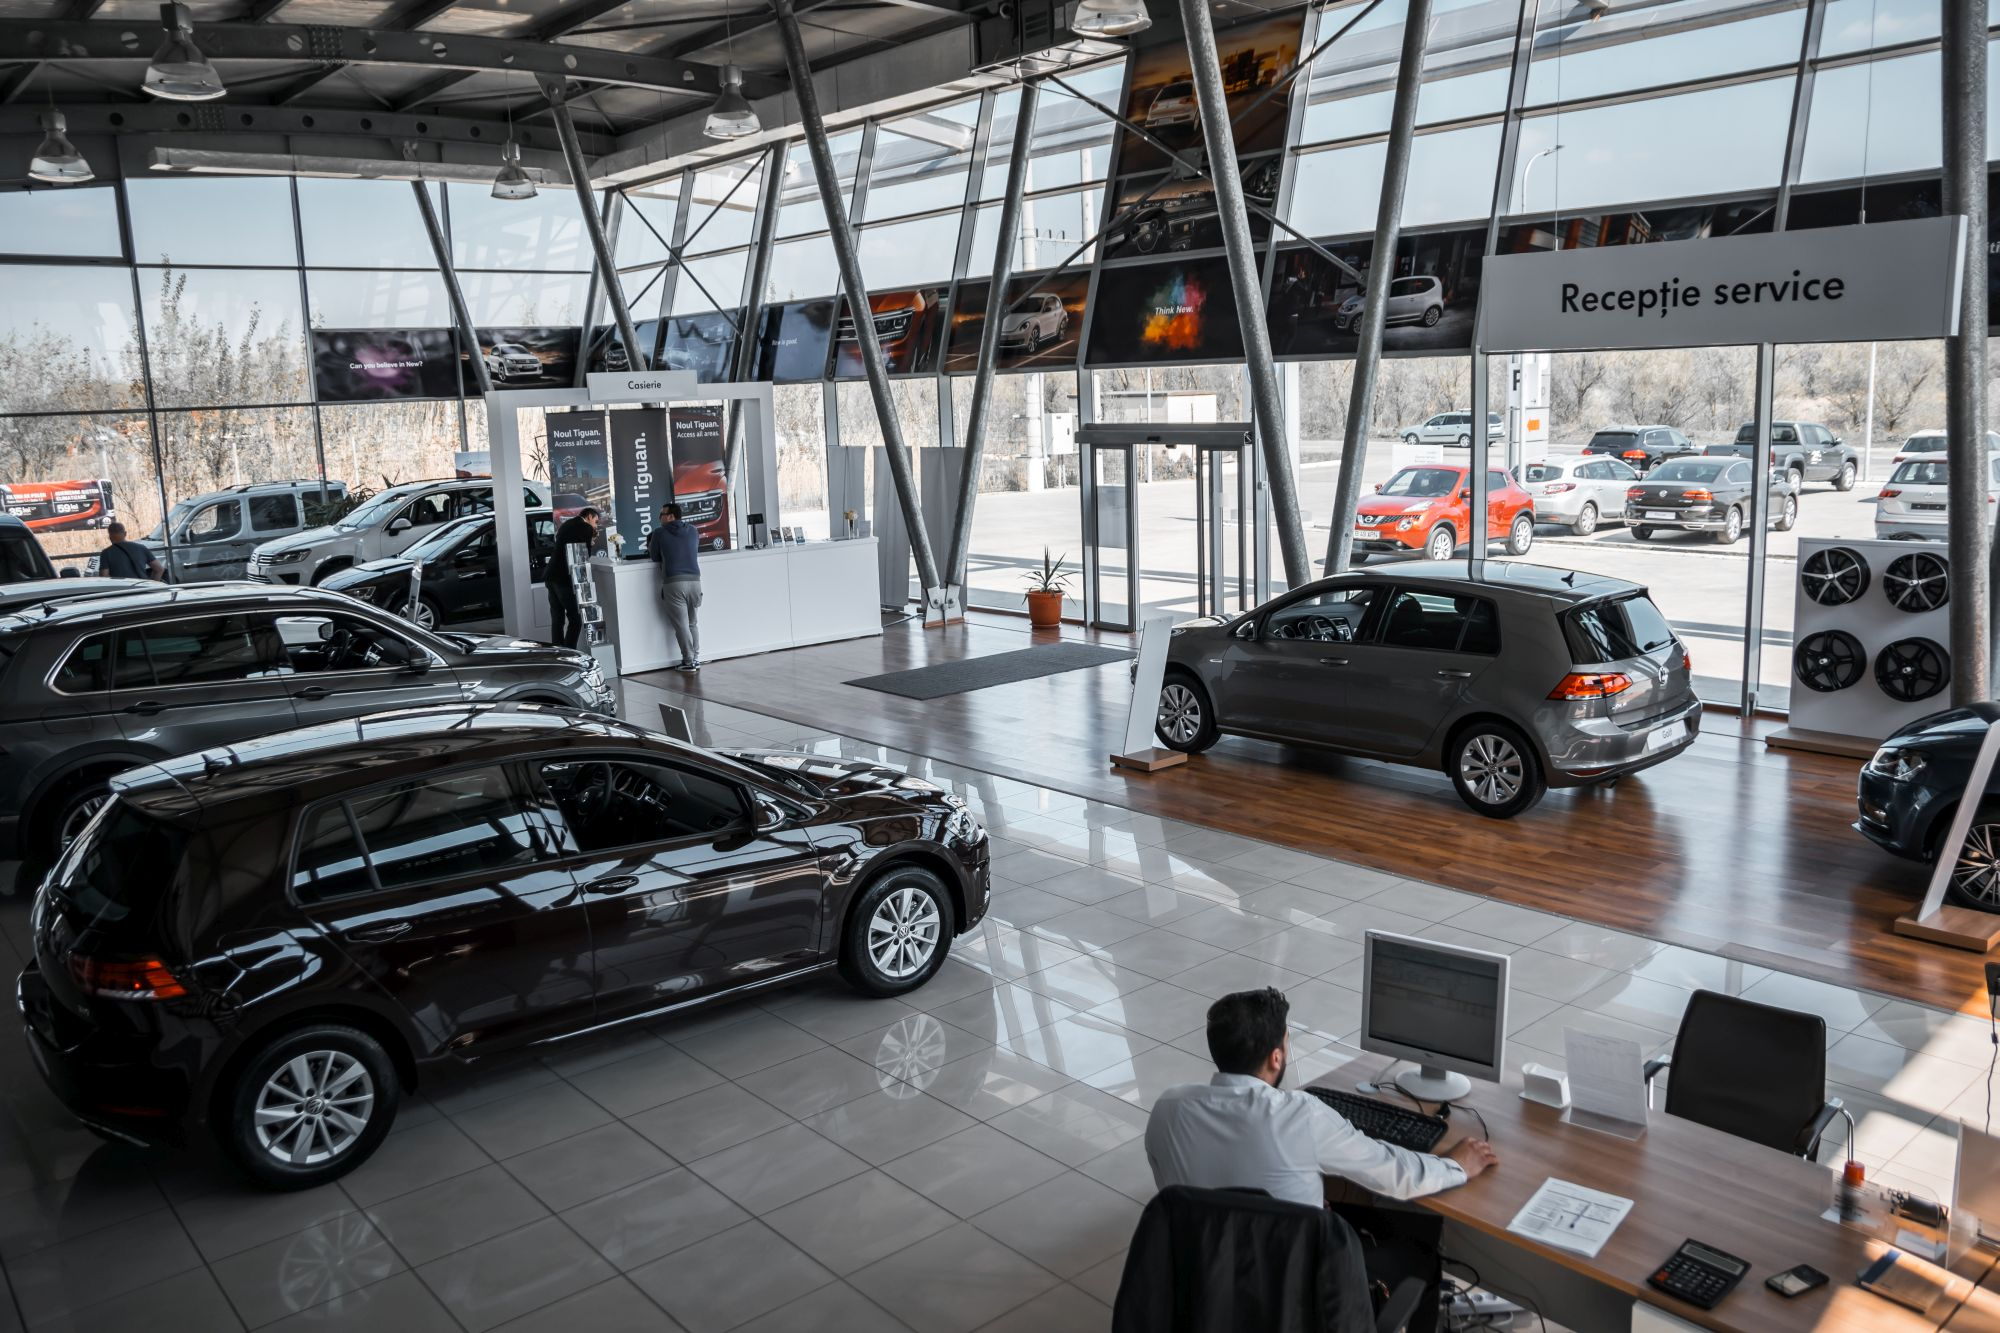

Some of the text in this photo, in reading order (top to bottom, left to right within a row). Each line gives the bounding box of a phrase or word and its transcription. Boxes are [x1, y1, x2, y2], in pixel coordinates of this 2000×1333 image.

[1561, 270, 1845, 318] Recepție service
[1155, 306, 1175, 316] Think
[628, 380, 662, 390] Casierie
[676, 420, 720, 430] Noul Tiguan.
[553, 429, 601, 439] Noul Tiguan.
[633, 432, 652, 551] Noul Tiguan.
[57, 504, 70, 513] 59
